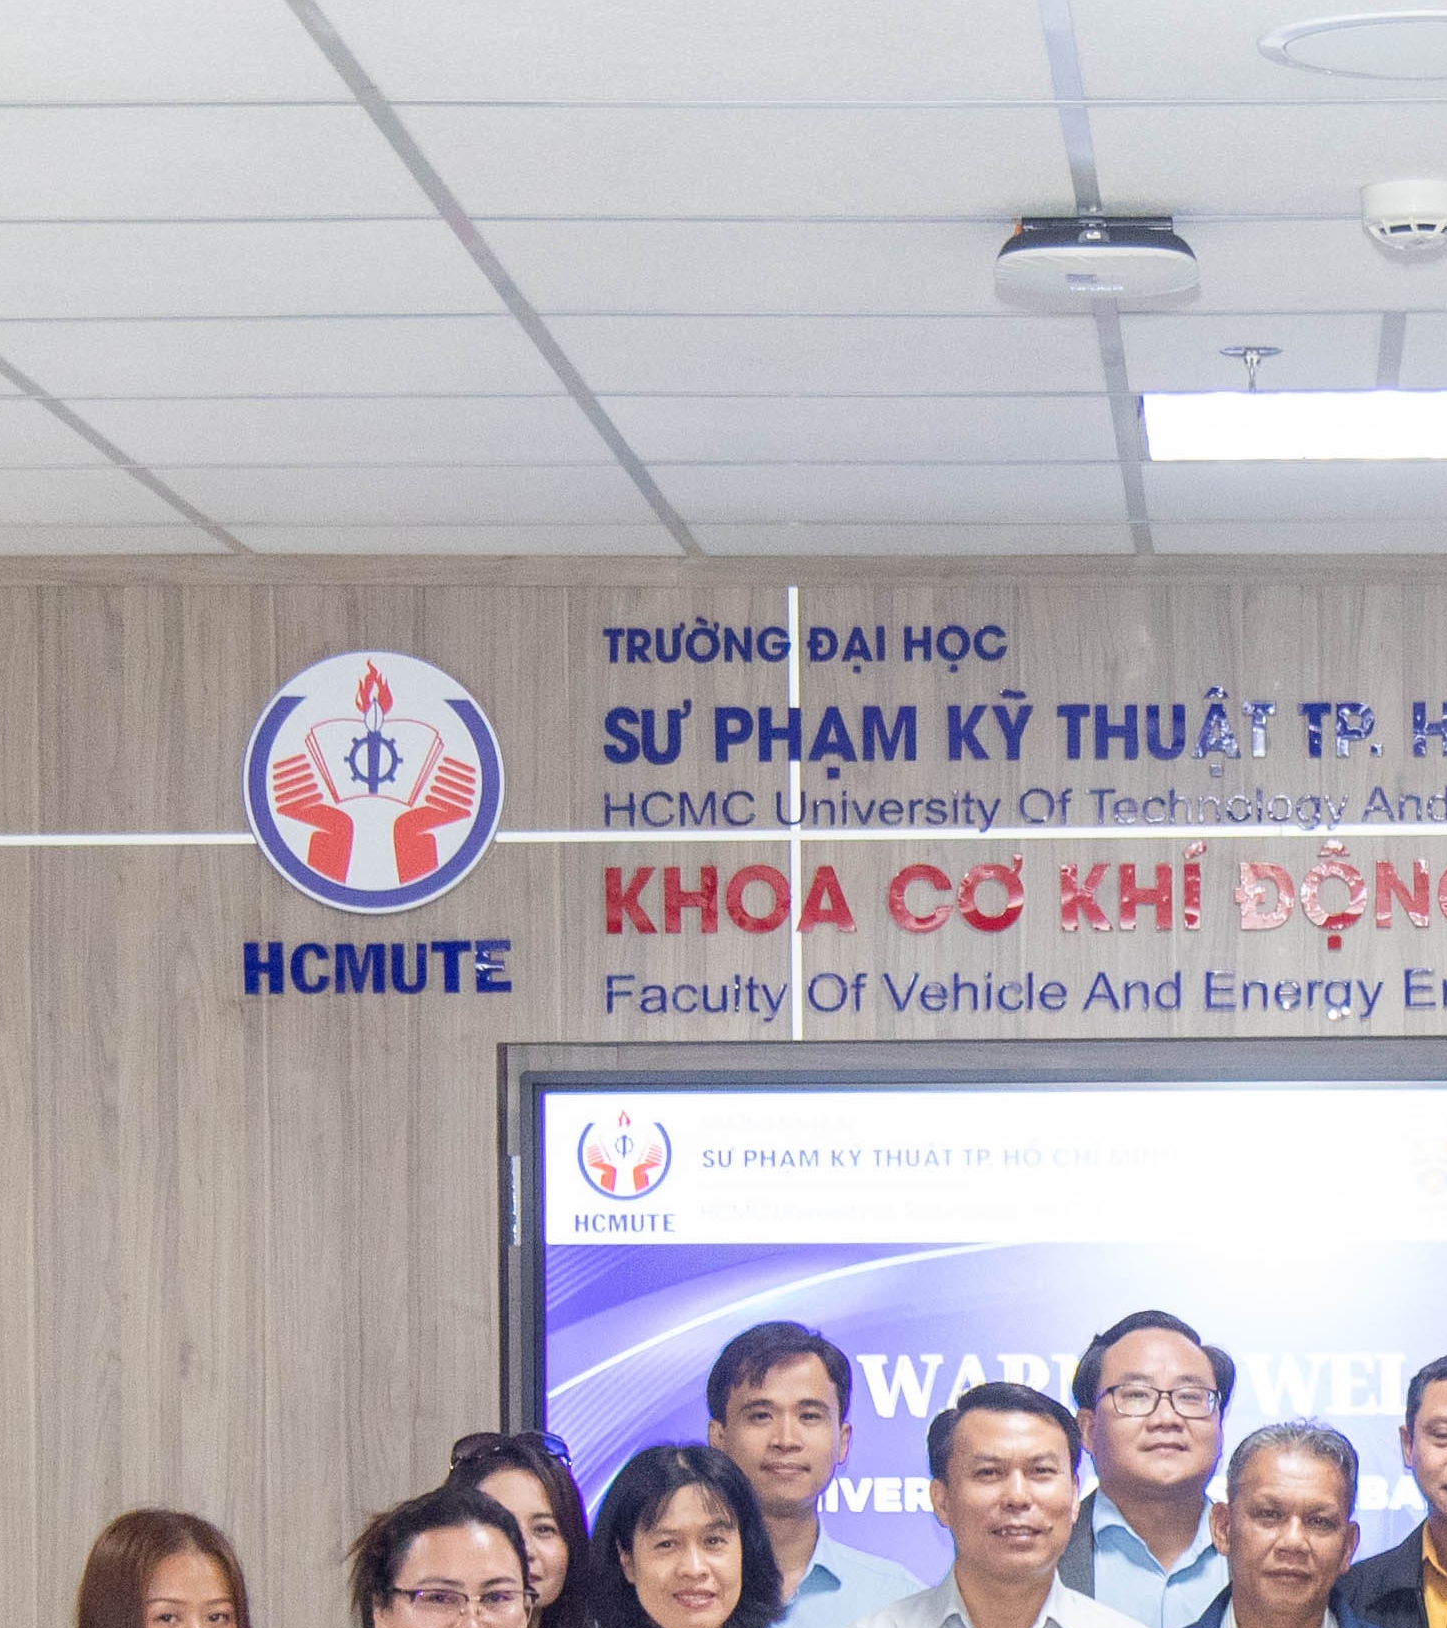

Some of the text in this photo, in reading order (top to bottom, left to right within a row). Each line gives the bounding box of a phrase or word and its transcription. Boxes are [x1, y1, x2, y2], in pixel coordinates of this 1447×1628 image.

[604, 617, 1008, 673] TRƯỜNG ĐẠI HỌC
[603, 699, 691, 764] SƯ
[715, 705, 917, 780] PHẠM
[948, 689, 1033, 762] KỸ
[1057, 686, 1275, 777] THUẬT
[1299, 702, 1382, 758] TP.
[604, 791, 756, 827] HCMC
[775, 789, 1001, 833] University
[1019, 787, 1072, 825] Of
[1089, 787, 1350, 831] Technology
[605, 865, 857, 934] KHOA
[888, 854, 1025, 934] CƠ
[1060, 840, 1208, 932] KHÍ
[243, 939, 512, 995] HCMUTE
[606, 974, 787, 1023] Faculty
[807, 971, 867, 1014] Of
[882, 971, 1068, 1014] Vehicle
[1083, 971, 1182, 1013] And
[1205, 968, 1384, 1020] Energy
[574, 1212, 677, 1234] HCMUTE
